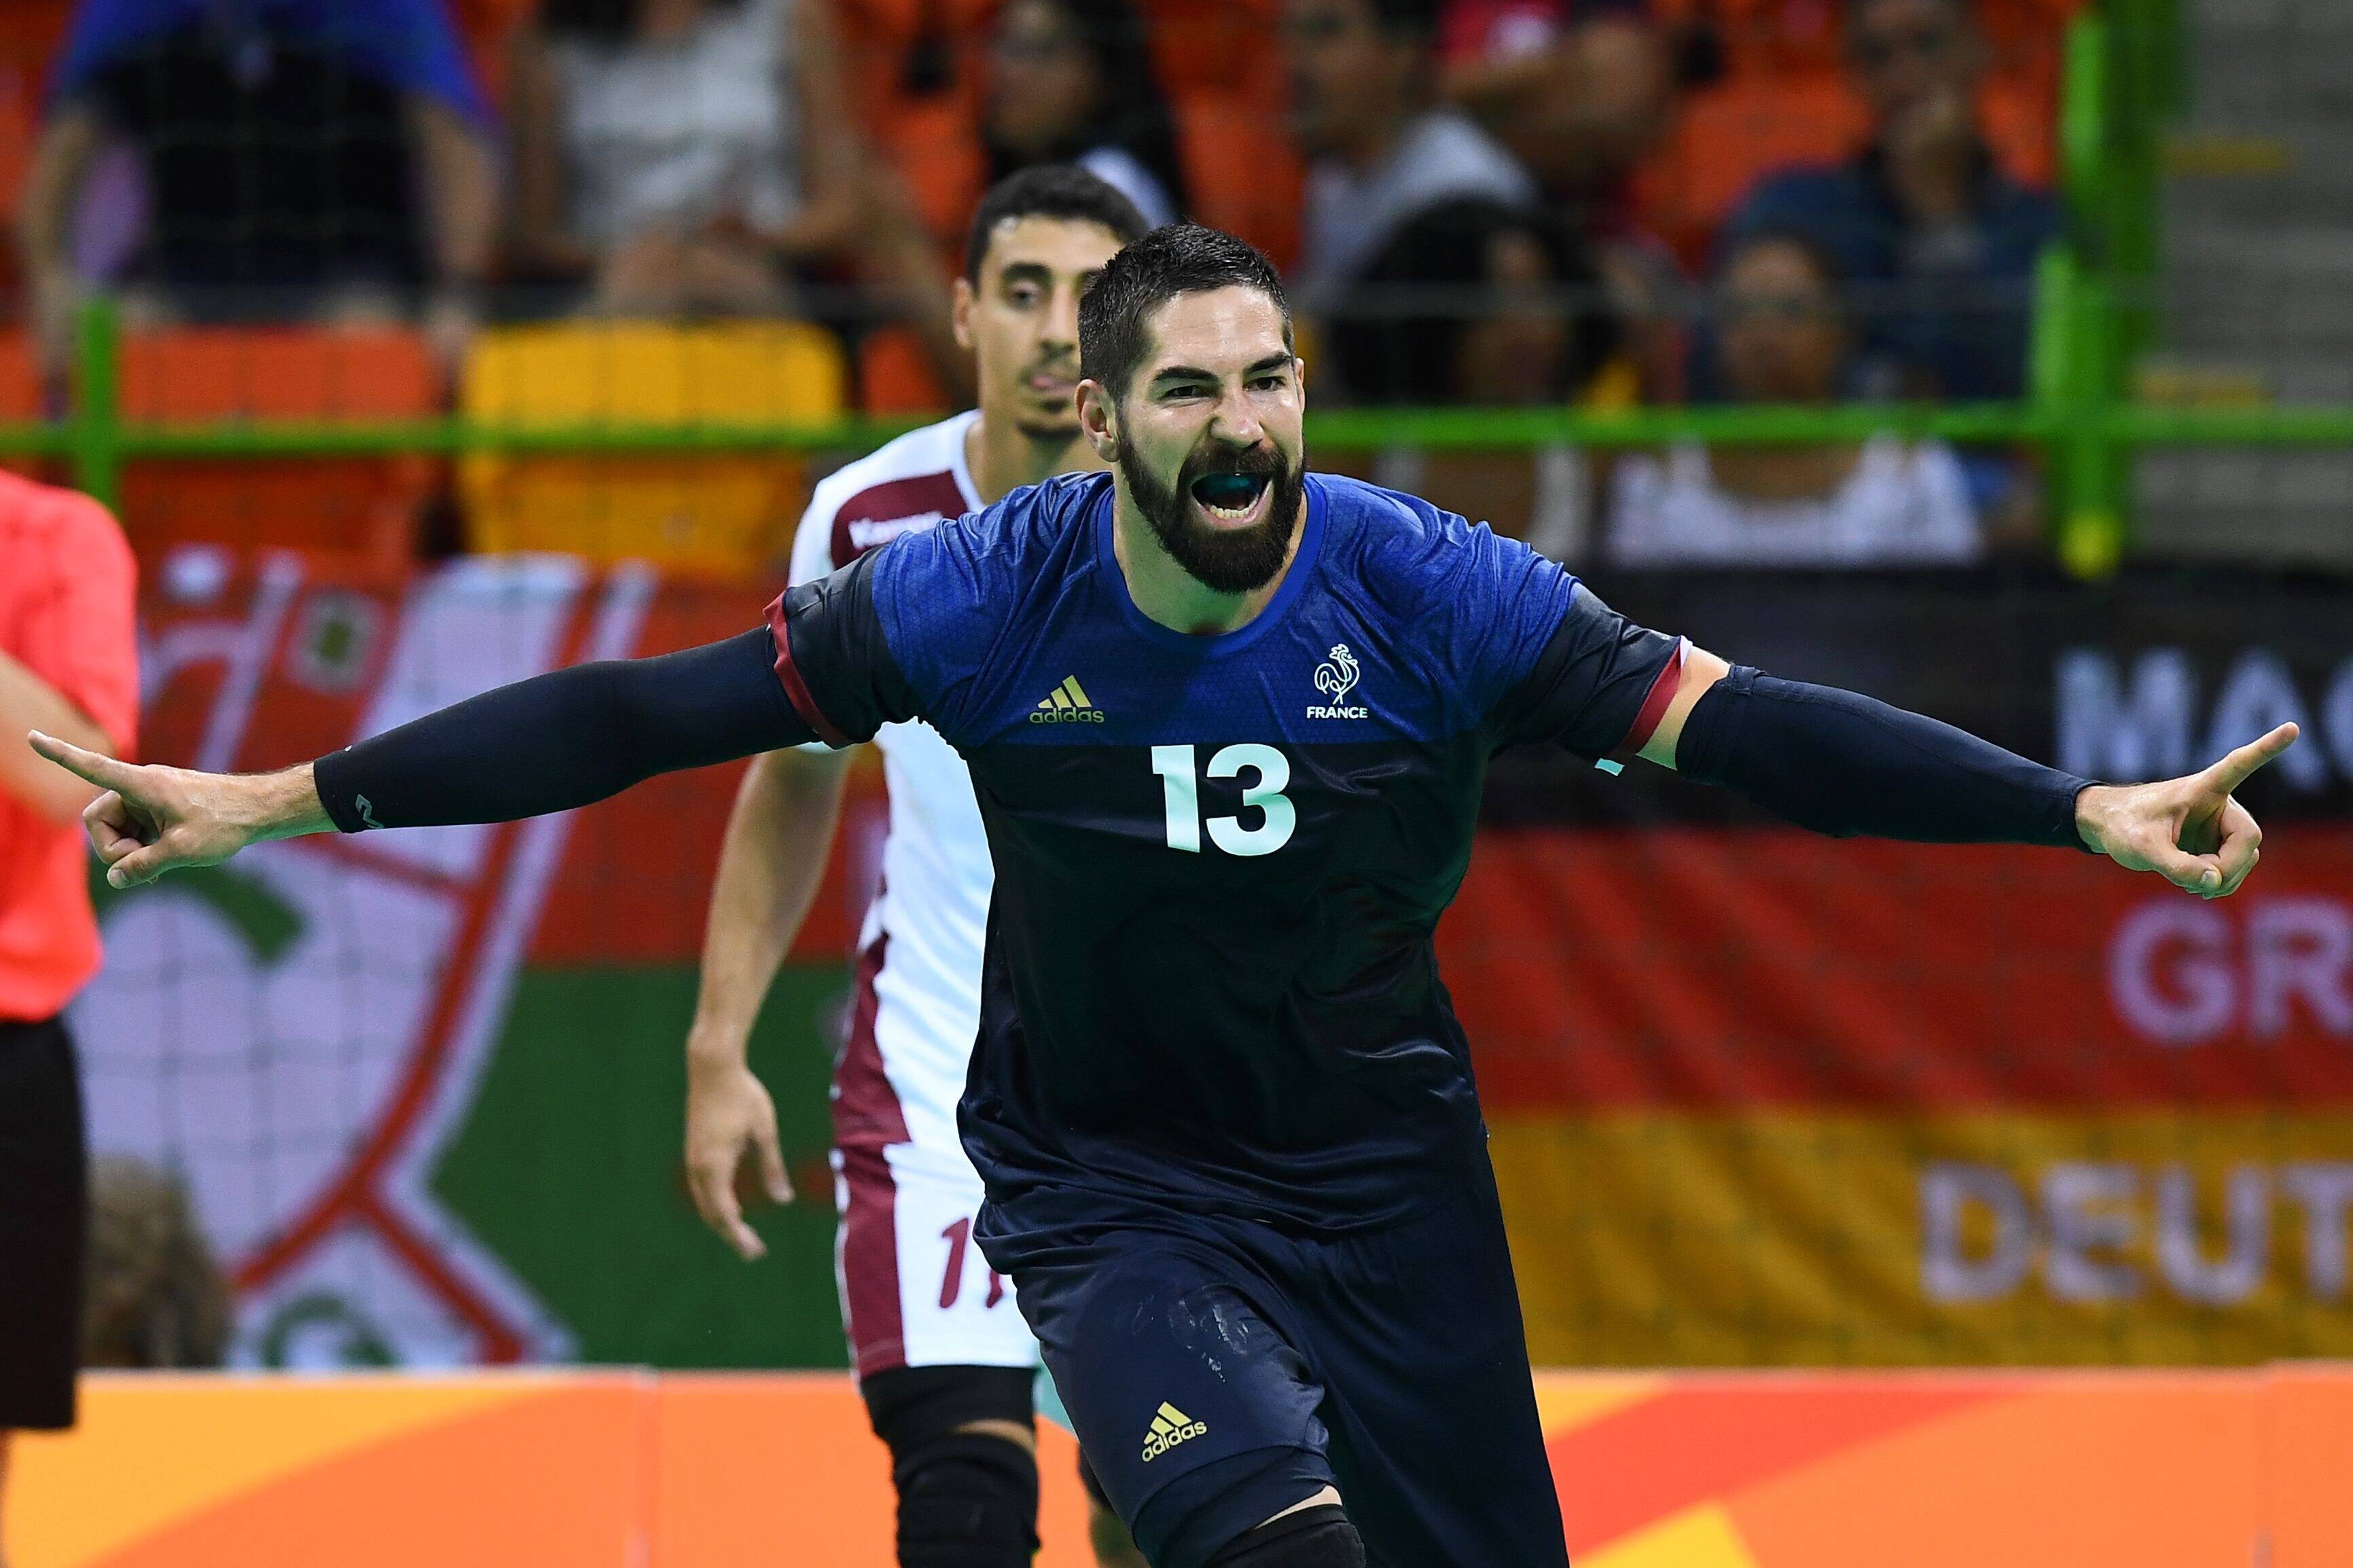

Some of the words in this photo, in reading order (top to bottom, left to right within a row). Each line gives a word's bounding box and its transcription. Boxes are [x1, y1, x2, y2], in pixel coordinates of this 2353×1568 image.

[1029, 707, 1104, 723] adidas
[1306, 706, 1368, 718] FRANCE
[2053, 646, 2353, 790] MA
[1151, 744, 1296, 856] 13
[1142, 1421, 1208, 1462] adidas
